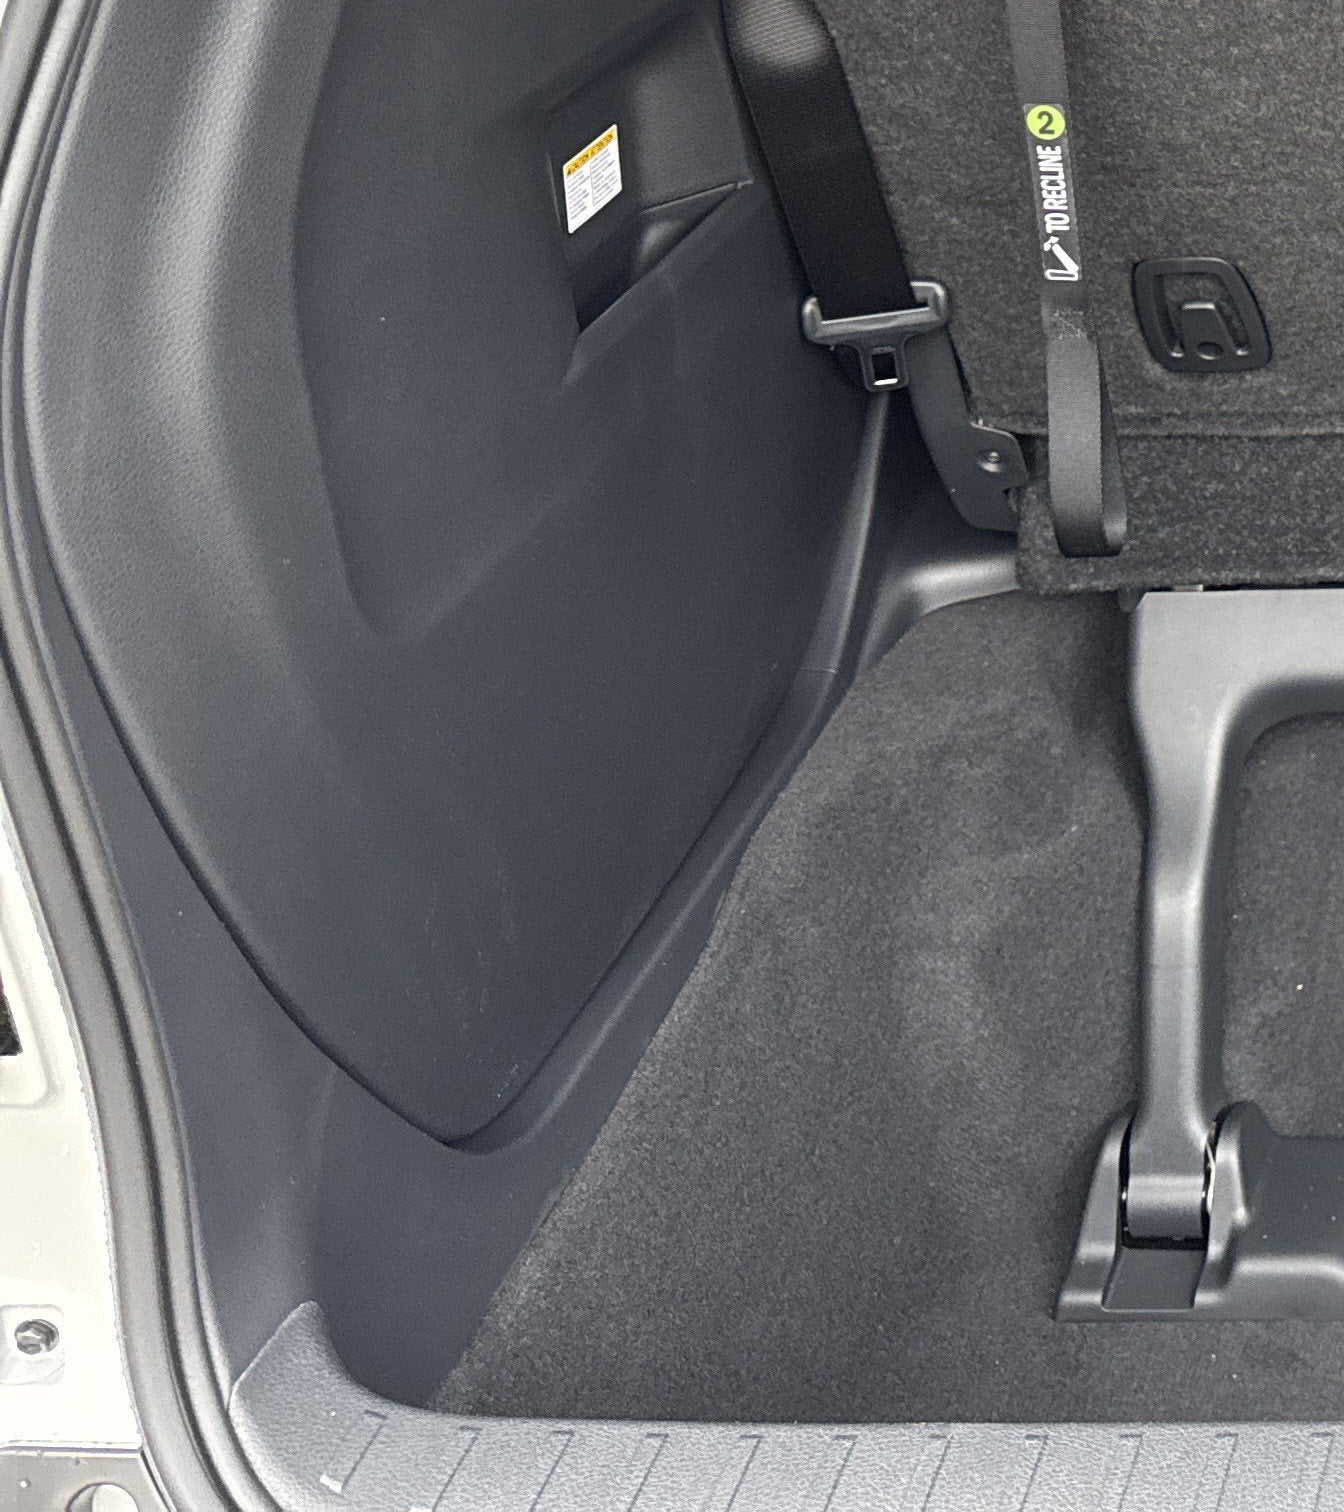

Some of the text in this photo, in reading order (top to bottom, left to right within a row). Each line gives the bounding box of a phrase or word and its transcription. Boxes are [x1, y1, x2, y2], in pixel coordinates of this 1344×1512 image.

[1036, 110, 1056, 135] 2
[1036, 144, 1070, 234] TO RECLINE
